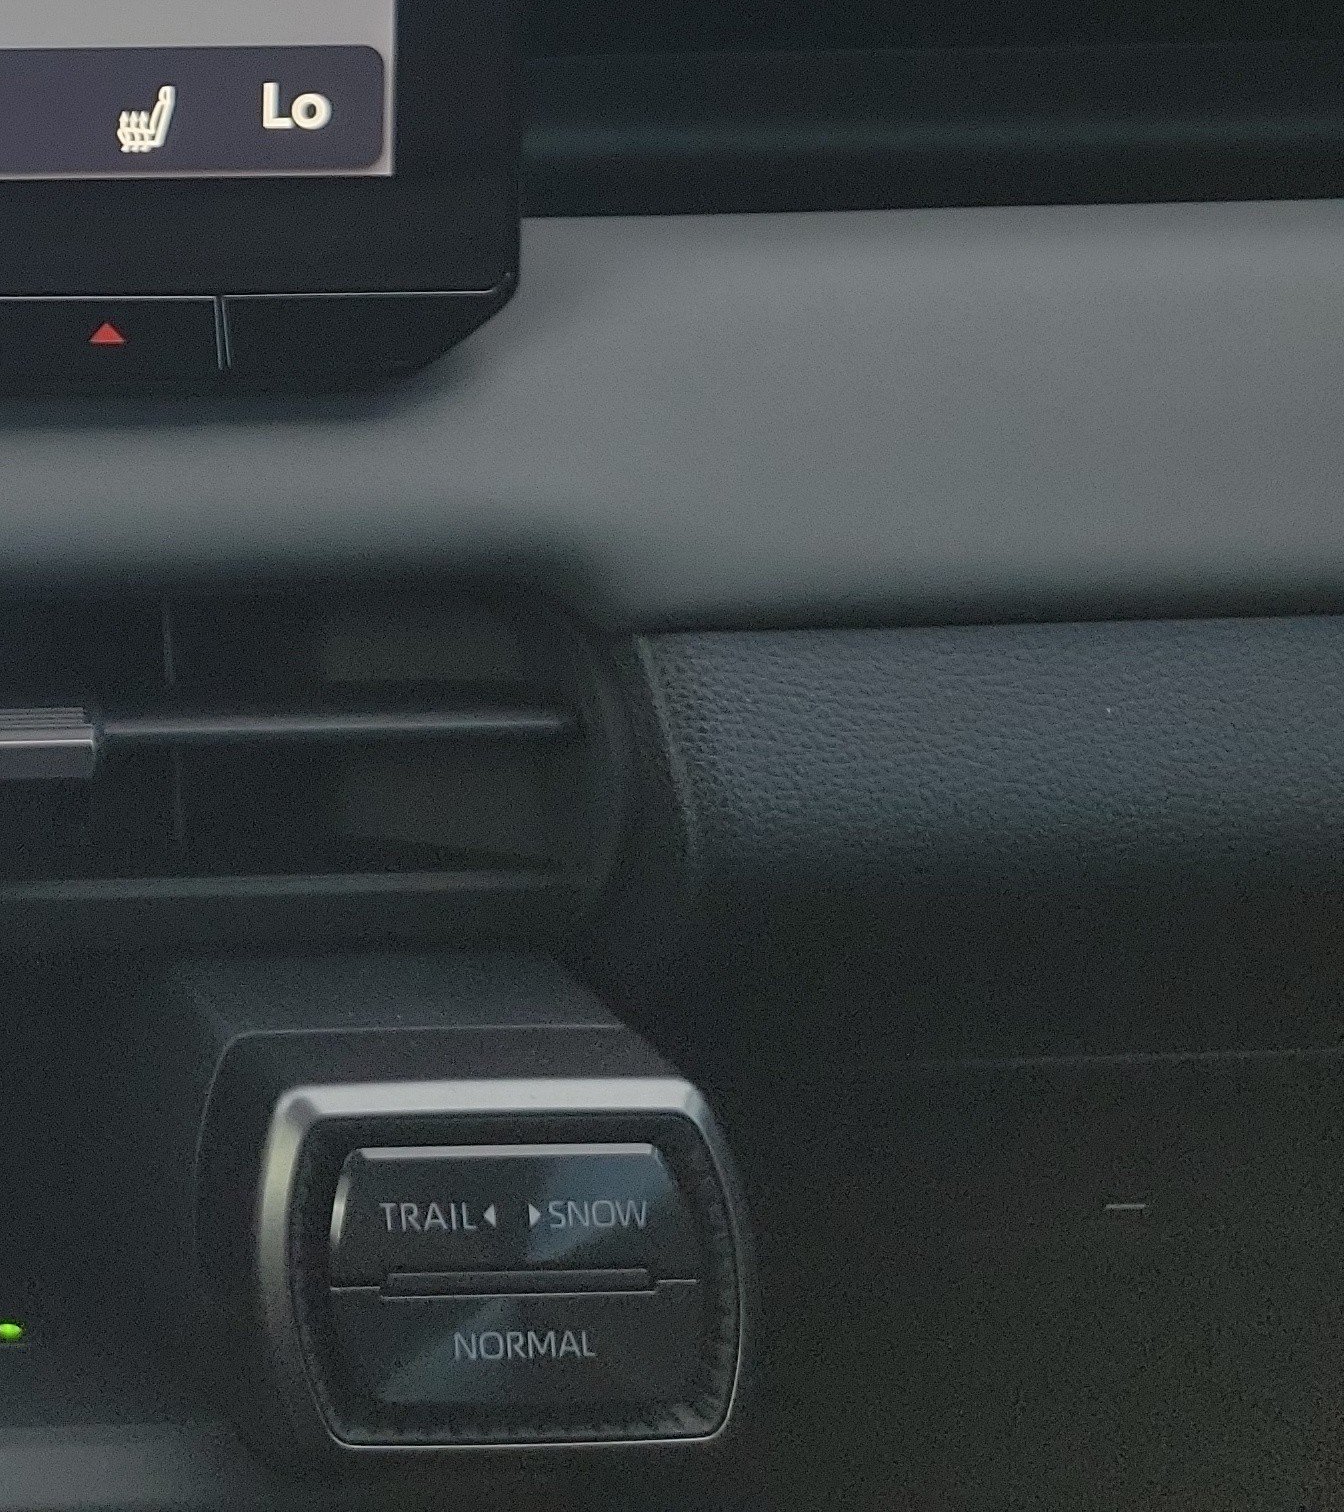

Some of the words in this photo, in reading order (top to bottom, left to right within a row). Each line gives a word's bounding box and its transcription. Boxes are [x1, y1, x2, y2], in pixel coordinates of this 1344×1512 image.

[261, 82, 332, 131] Lo
[379, 1201, 477, 1233] TRAIL
[548, 1199, 648, 1230] SNOW
[453, 1330, 596, 1361] NORMAL
